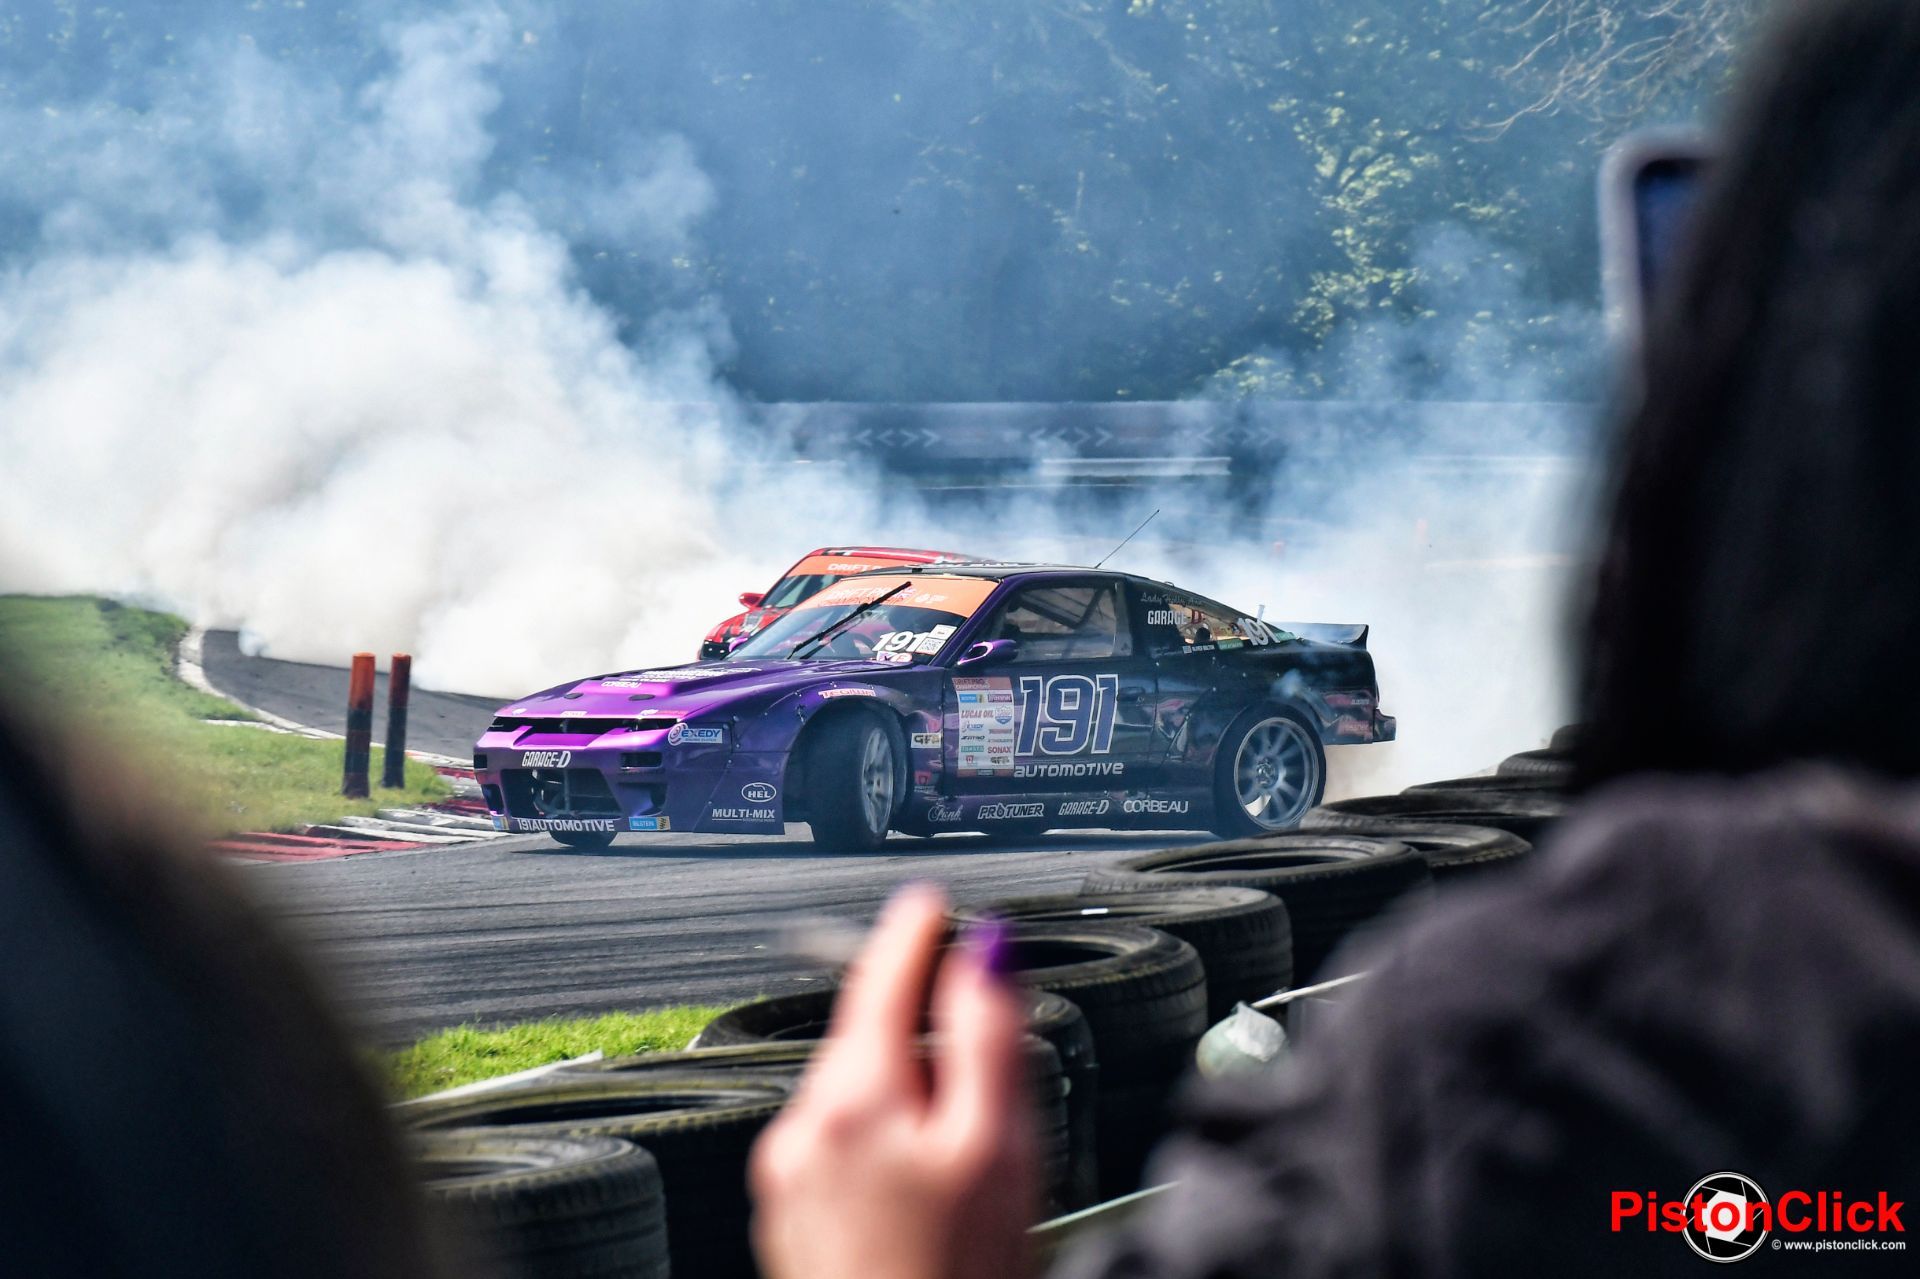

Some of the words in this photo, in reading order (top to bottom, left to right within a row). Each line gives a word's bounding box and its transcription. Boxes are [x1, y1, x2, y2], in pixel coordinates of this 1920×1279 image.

[827, 563, 869, 571] DRIFT
[1236, 617, 1281, 646] 191
[872, 631, 929, 652] 191
[1014, 674, 1119, 757] 191
[682, 729, 720, 738] EXEDY
[987, 746, 1012, 754] SONAX
[522, 751, 571, 768] GARAGE-D
[747, 790, 771, 798] HEL
[1058, 800, 1110, 816] GARAGE-D
[1123, 800, 1189, 813] CORBEAU
[712, 808, 776, 819] MULTI-MIX
